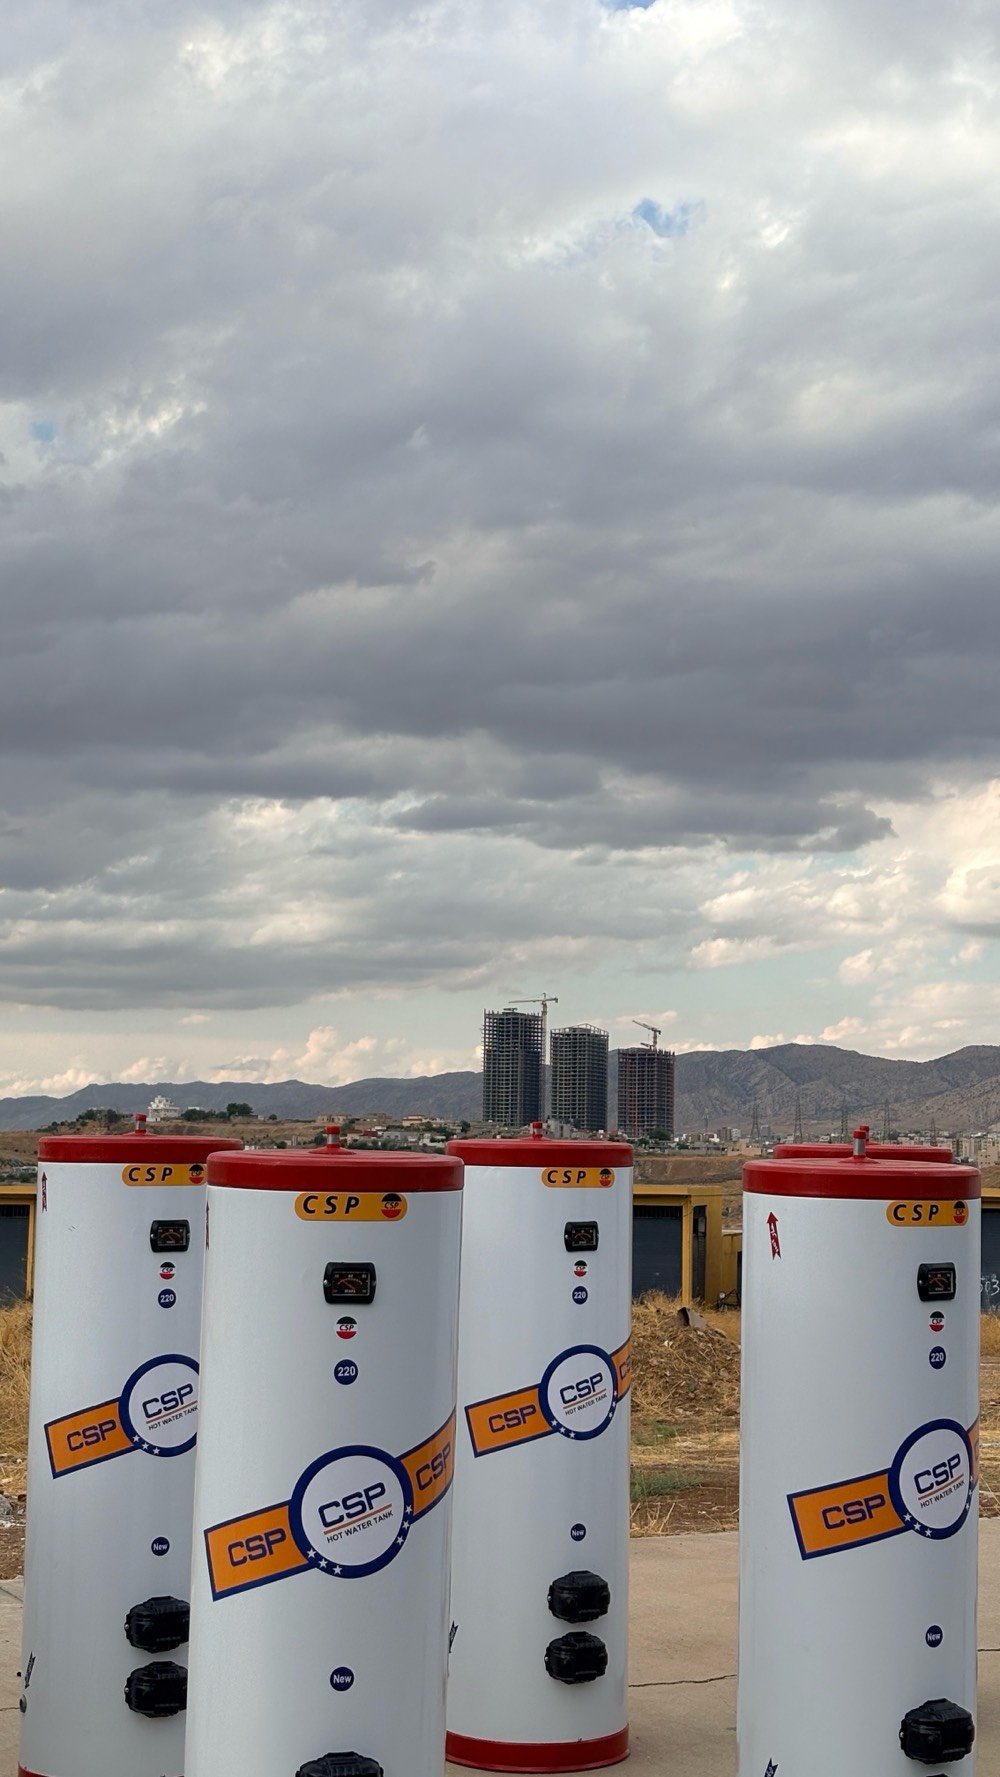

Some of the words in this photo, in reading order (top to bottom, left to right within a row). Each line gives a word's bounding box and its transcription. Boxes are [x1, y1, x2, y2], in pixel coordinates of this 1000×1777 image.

[128, 1167, 173, 1181] CSP
[547, 1170, 586, 1183] CSP
[303, 1196, 360, 1214] CSP
[893, 1204, 939, 1221] CSP
[160, 1294, 175, 1303] 220
[573, 1291, 587, 1299] 220
[930, 1352, 944, 1362] 220
[337, 1366, 356, 1377] 220
[560, 1372, 603, 1404] CSP
[142, 1383, 193, 1418] CSP
[565, 1408, 577, 1416] HOT
[577, 1399, 596, 1411] WATER
[148, 1421, 161, 1431] HOT
[162, 1412, 183, 1426] WATER
[183, 1405, 198, 1416] TANK
[488, 1404, 536, 1433] CSP
[67, 1420, 117, 1451] CSP
[415, 1441, 451, 1491] CSP
[914, 1453, 961, 1494] CSP
[920, 1498, 934, 1509] HOT
[934, 1487, 953, 1503] WATER
[953, 1480, 965, 1491] TANK
[318, 1482, 386, 1528] CSP
[822, 1493, 886, 1530] CSP
[326, 1531, 343, 1544] HOT
[344, 1519, 373, 1537] WATER
[373, 1510, 394, 1524] TANK
[572, 1529, 584, 1537] New
[153, 1542, 168, 1551] New
[227, 1528, 287, 1567] CSP
[927, 1632, 941, 1642] New
[333, 1674, 352, 1684] New
